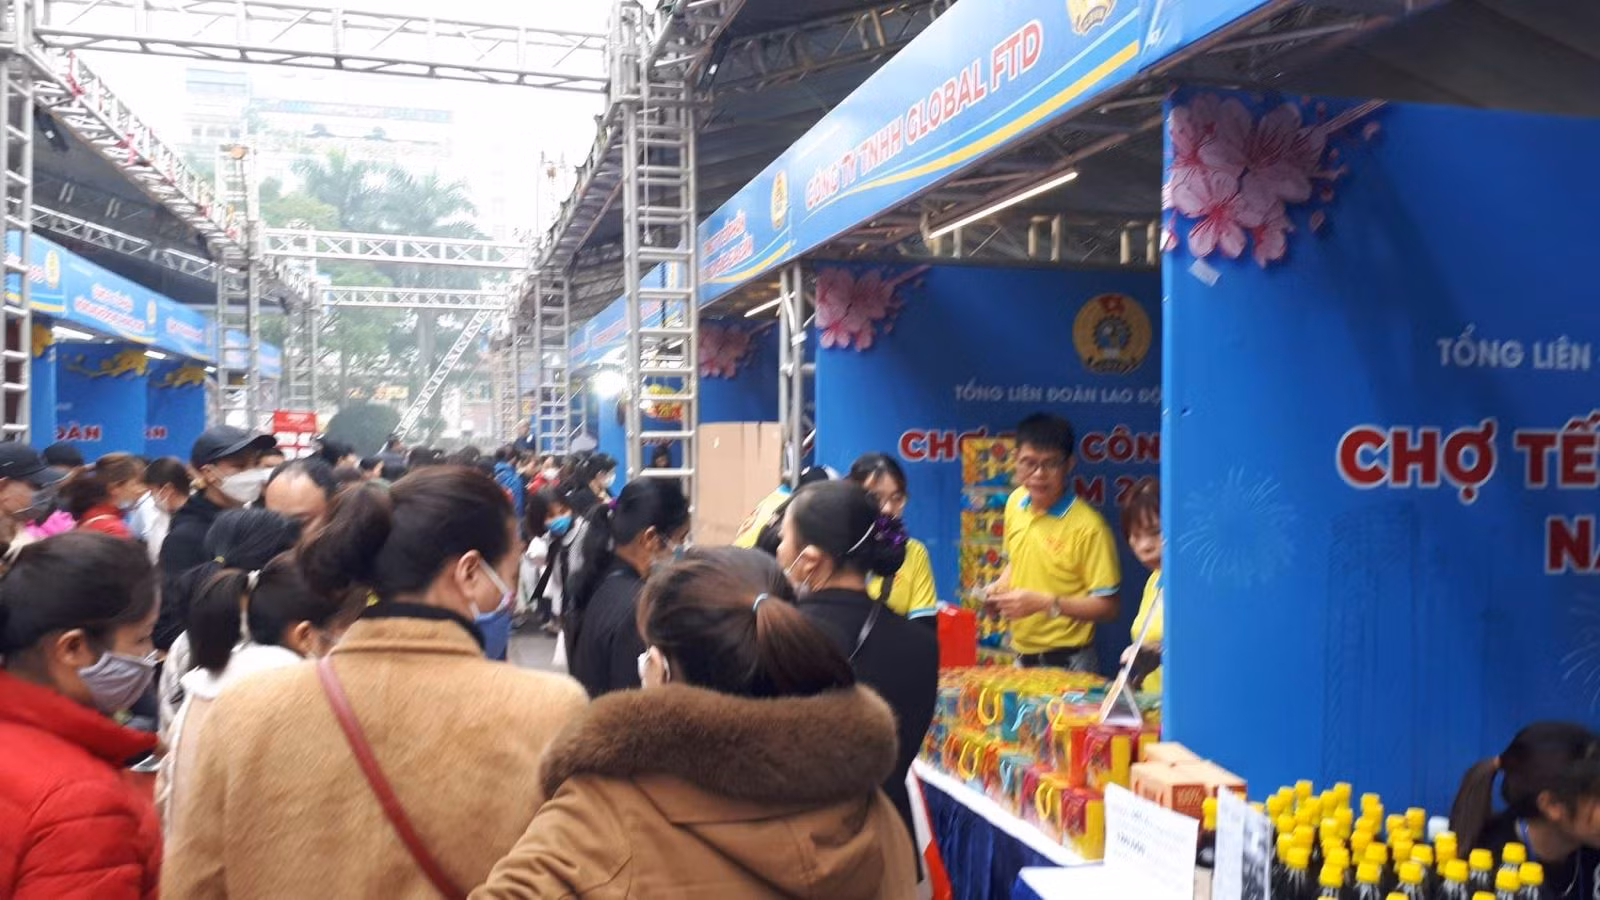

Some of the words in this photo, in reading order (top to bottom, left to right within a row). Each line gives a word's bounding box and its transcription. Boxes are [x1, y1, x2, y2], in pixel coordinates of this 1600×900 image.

[858, 115, 903, 176] TNHH
[905, 58, 987, 145] GLOBAL
[990, 19, 1043, 93] FTD
[1437, 323, 1526, 369] TỔNG
[1533, 335, 1592, 370] LIÊN
[955, 377, 1001, 401] TỔNG
[1008, 383, 1042, 402] LIÊN
[1102, 387, 1134, 403] LAO
[898, 424, 988, 463] CH
[1336, 417, 1498, 504] CHỢ
[1545, 516, 1600, 575] N
